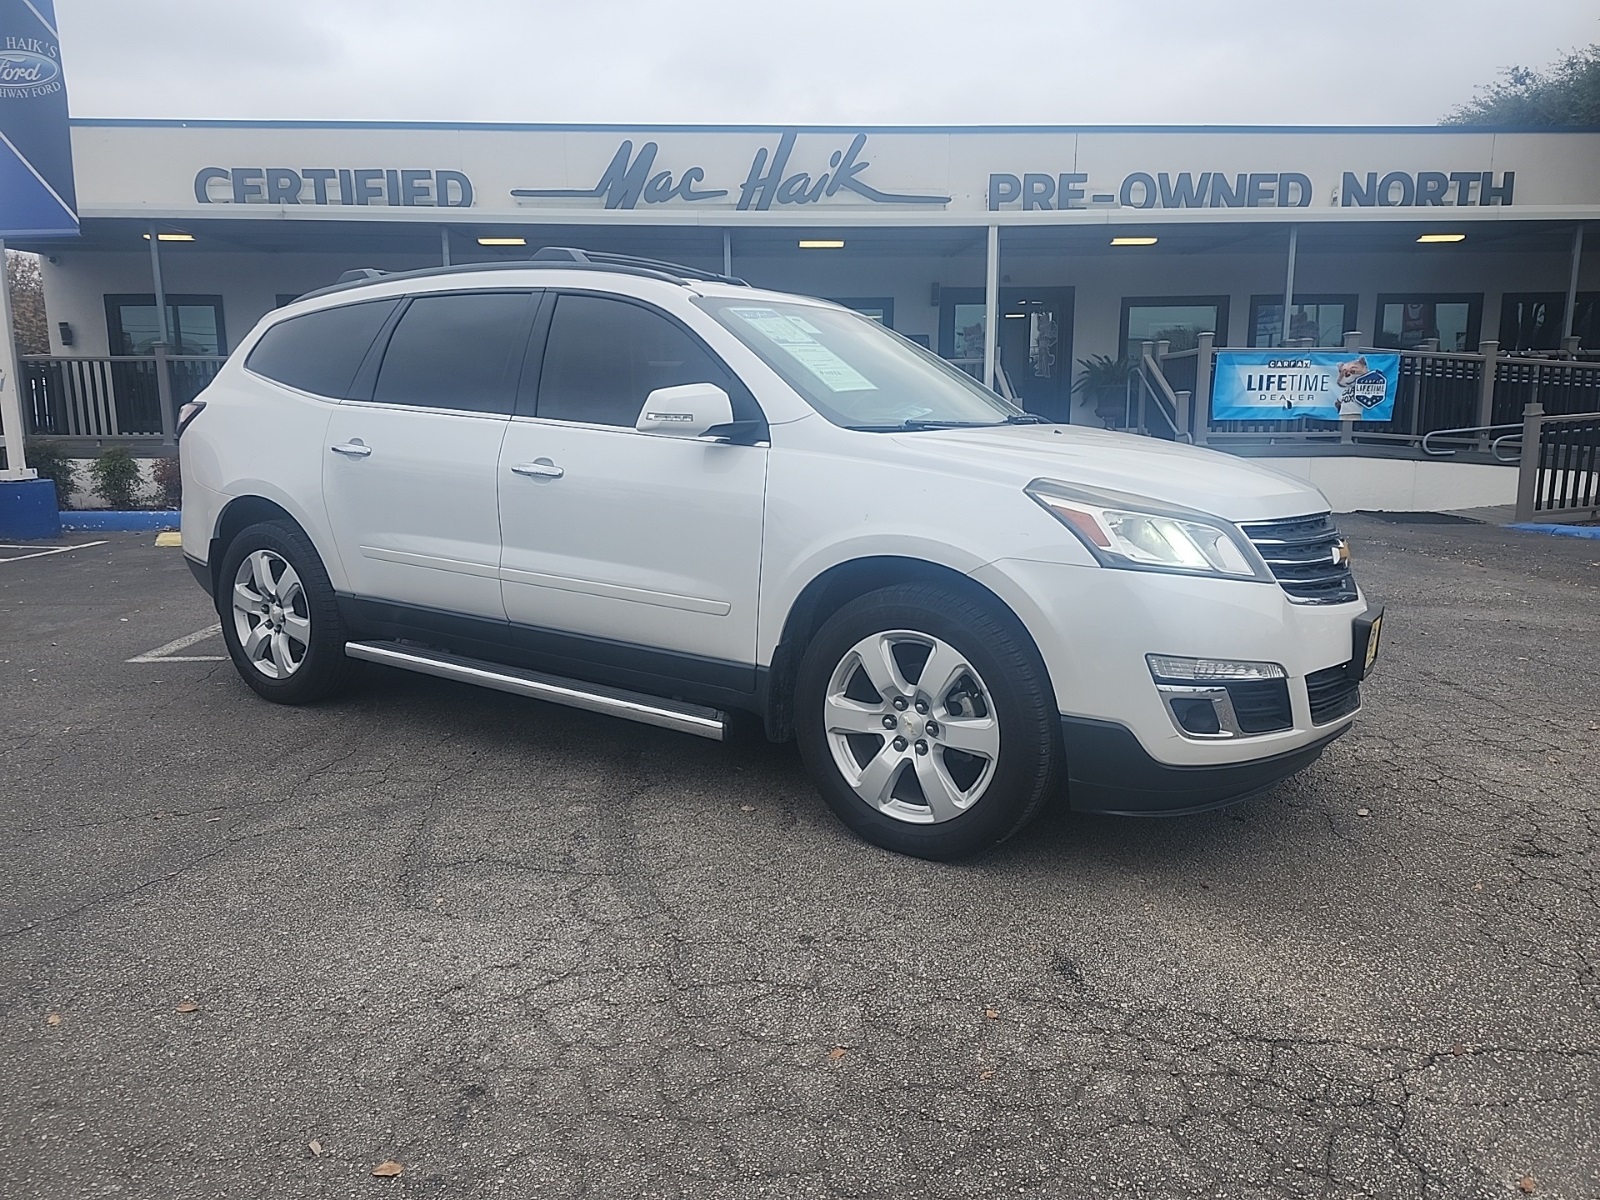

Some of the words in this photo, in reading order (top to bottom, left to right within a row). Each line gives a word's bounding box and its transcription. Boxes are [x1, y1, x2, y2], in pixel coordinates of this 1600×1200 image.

[6, 37, 57, 58] HAIK'S
[0, 55, 41, 80] Ford
[32, 82, 61, 97] FORD
[194, 167, 474, 208] CERTIFIED
[510, 139, 728, 210] Mac
[735, 127, 952, 211] Haik
[988, 171, 1312, 210] PRE-OWNED
[1341, 171, 1515, 207] NORTH
[1268, 360, 1312, 368] CARFAX
[1246, 374, 1330, 392] LIFETIME
